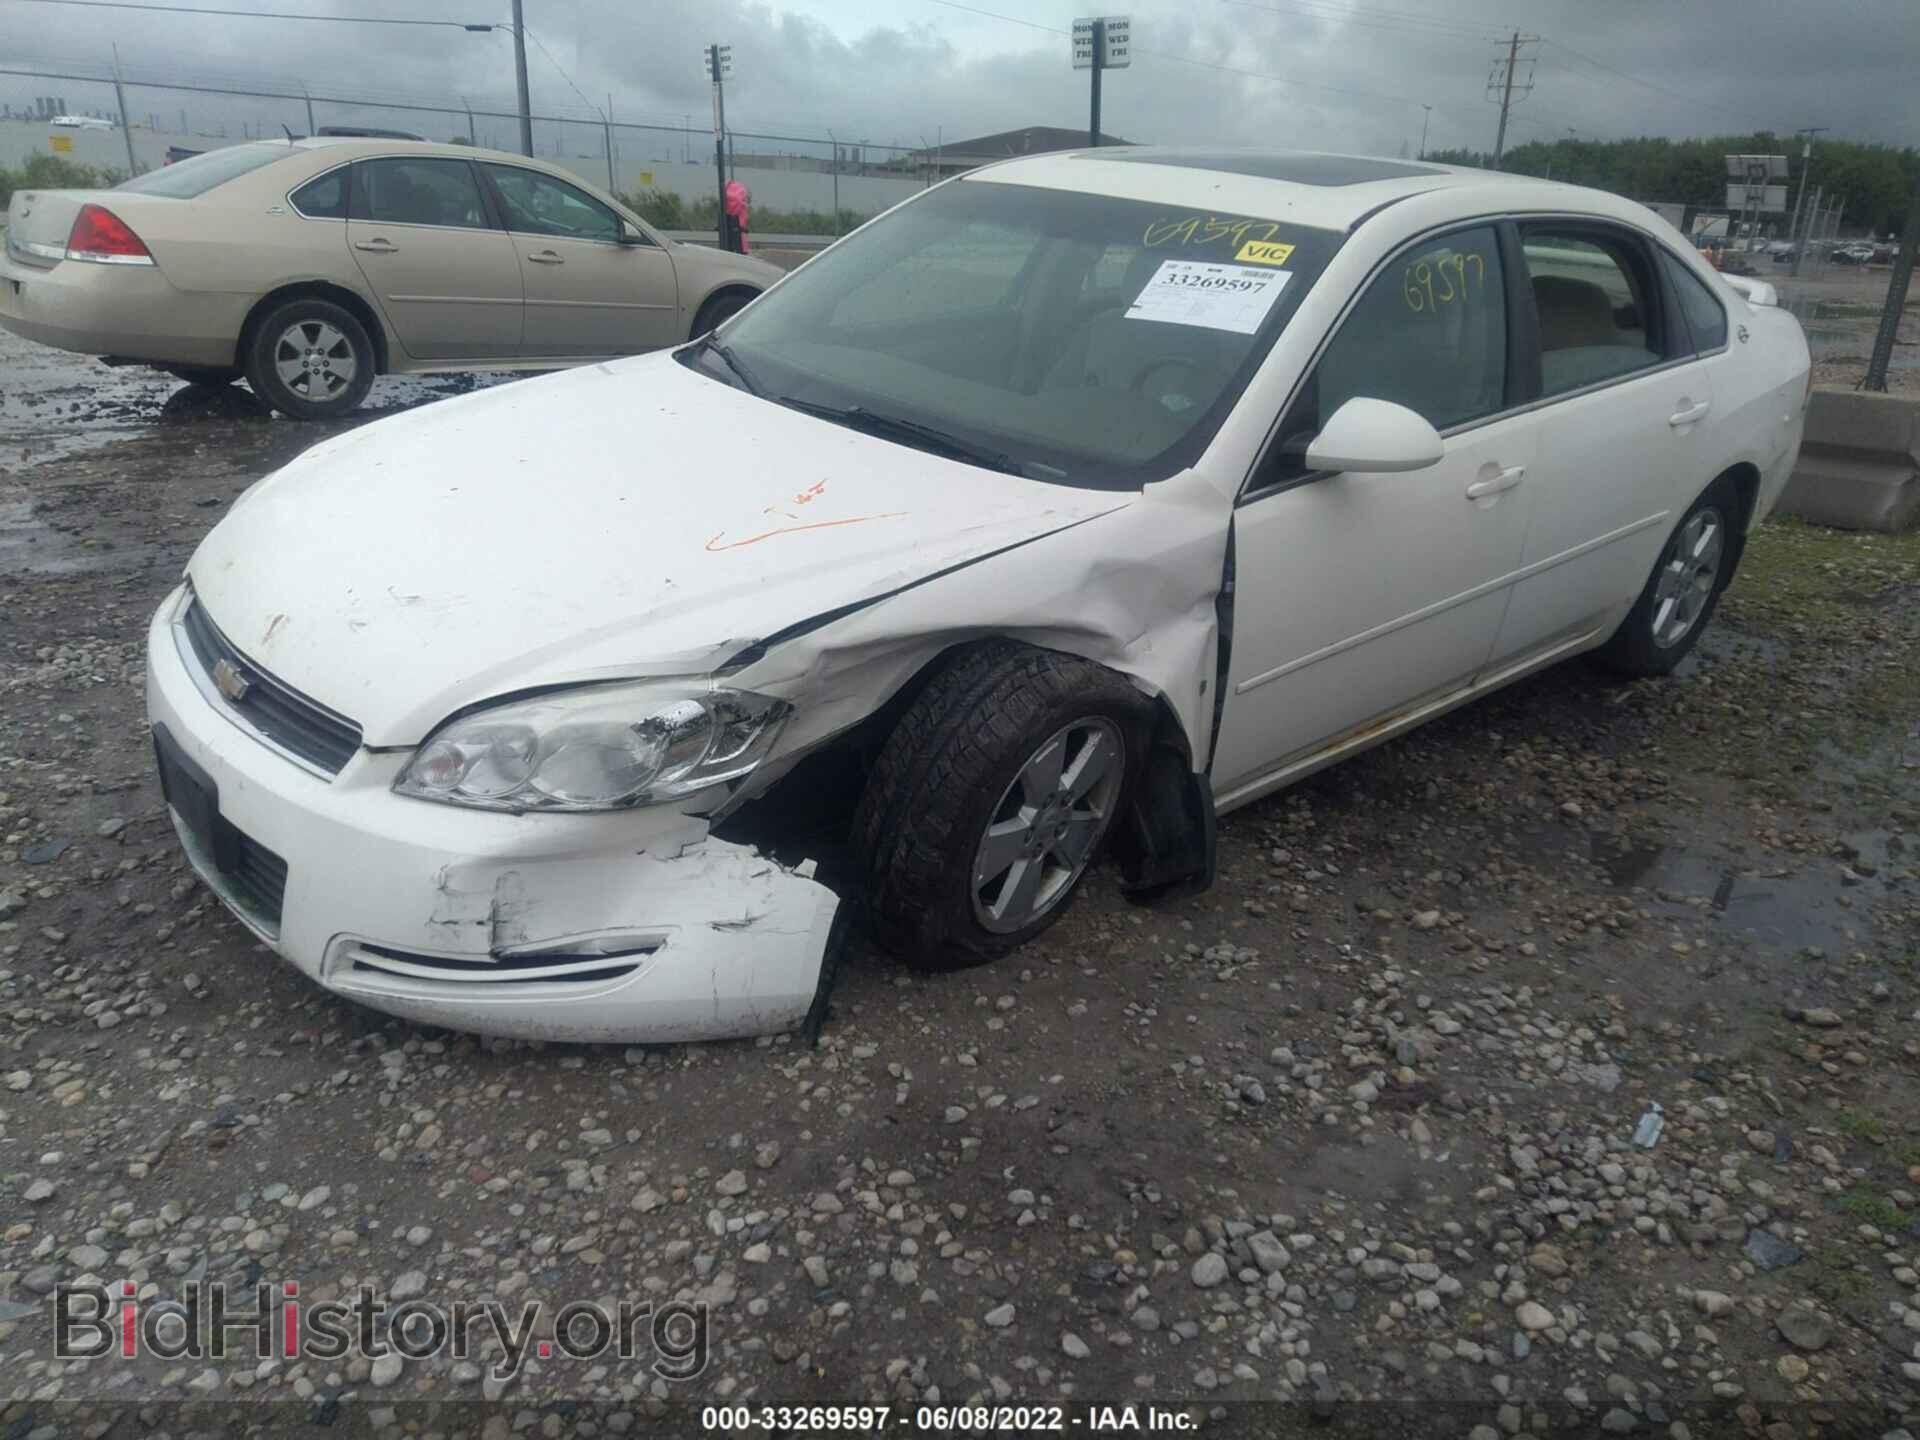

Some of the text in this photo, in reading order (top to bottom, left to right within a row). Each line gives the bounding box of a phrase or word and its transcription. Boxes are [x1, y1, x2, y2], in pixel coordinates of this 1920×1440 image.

[1248, 246, 1286, 259] VIC
[1161, 273, 1267, 293] 33269597
[1404, 253, 1484, 312] 69597
